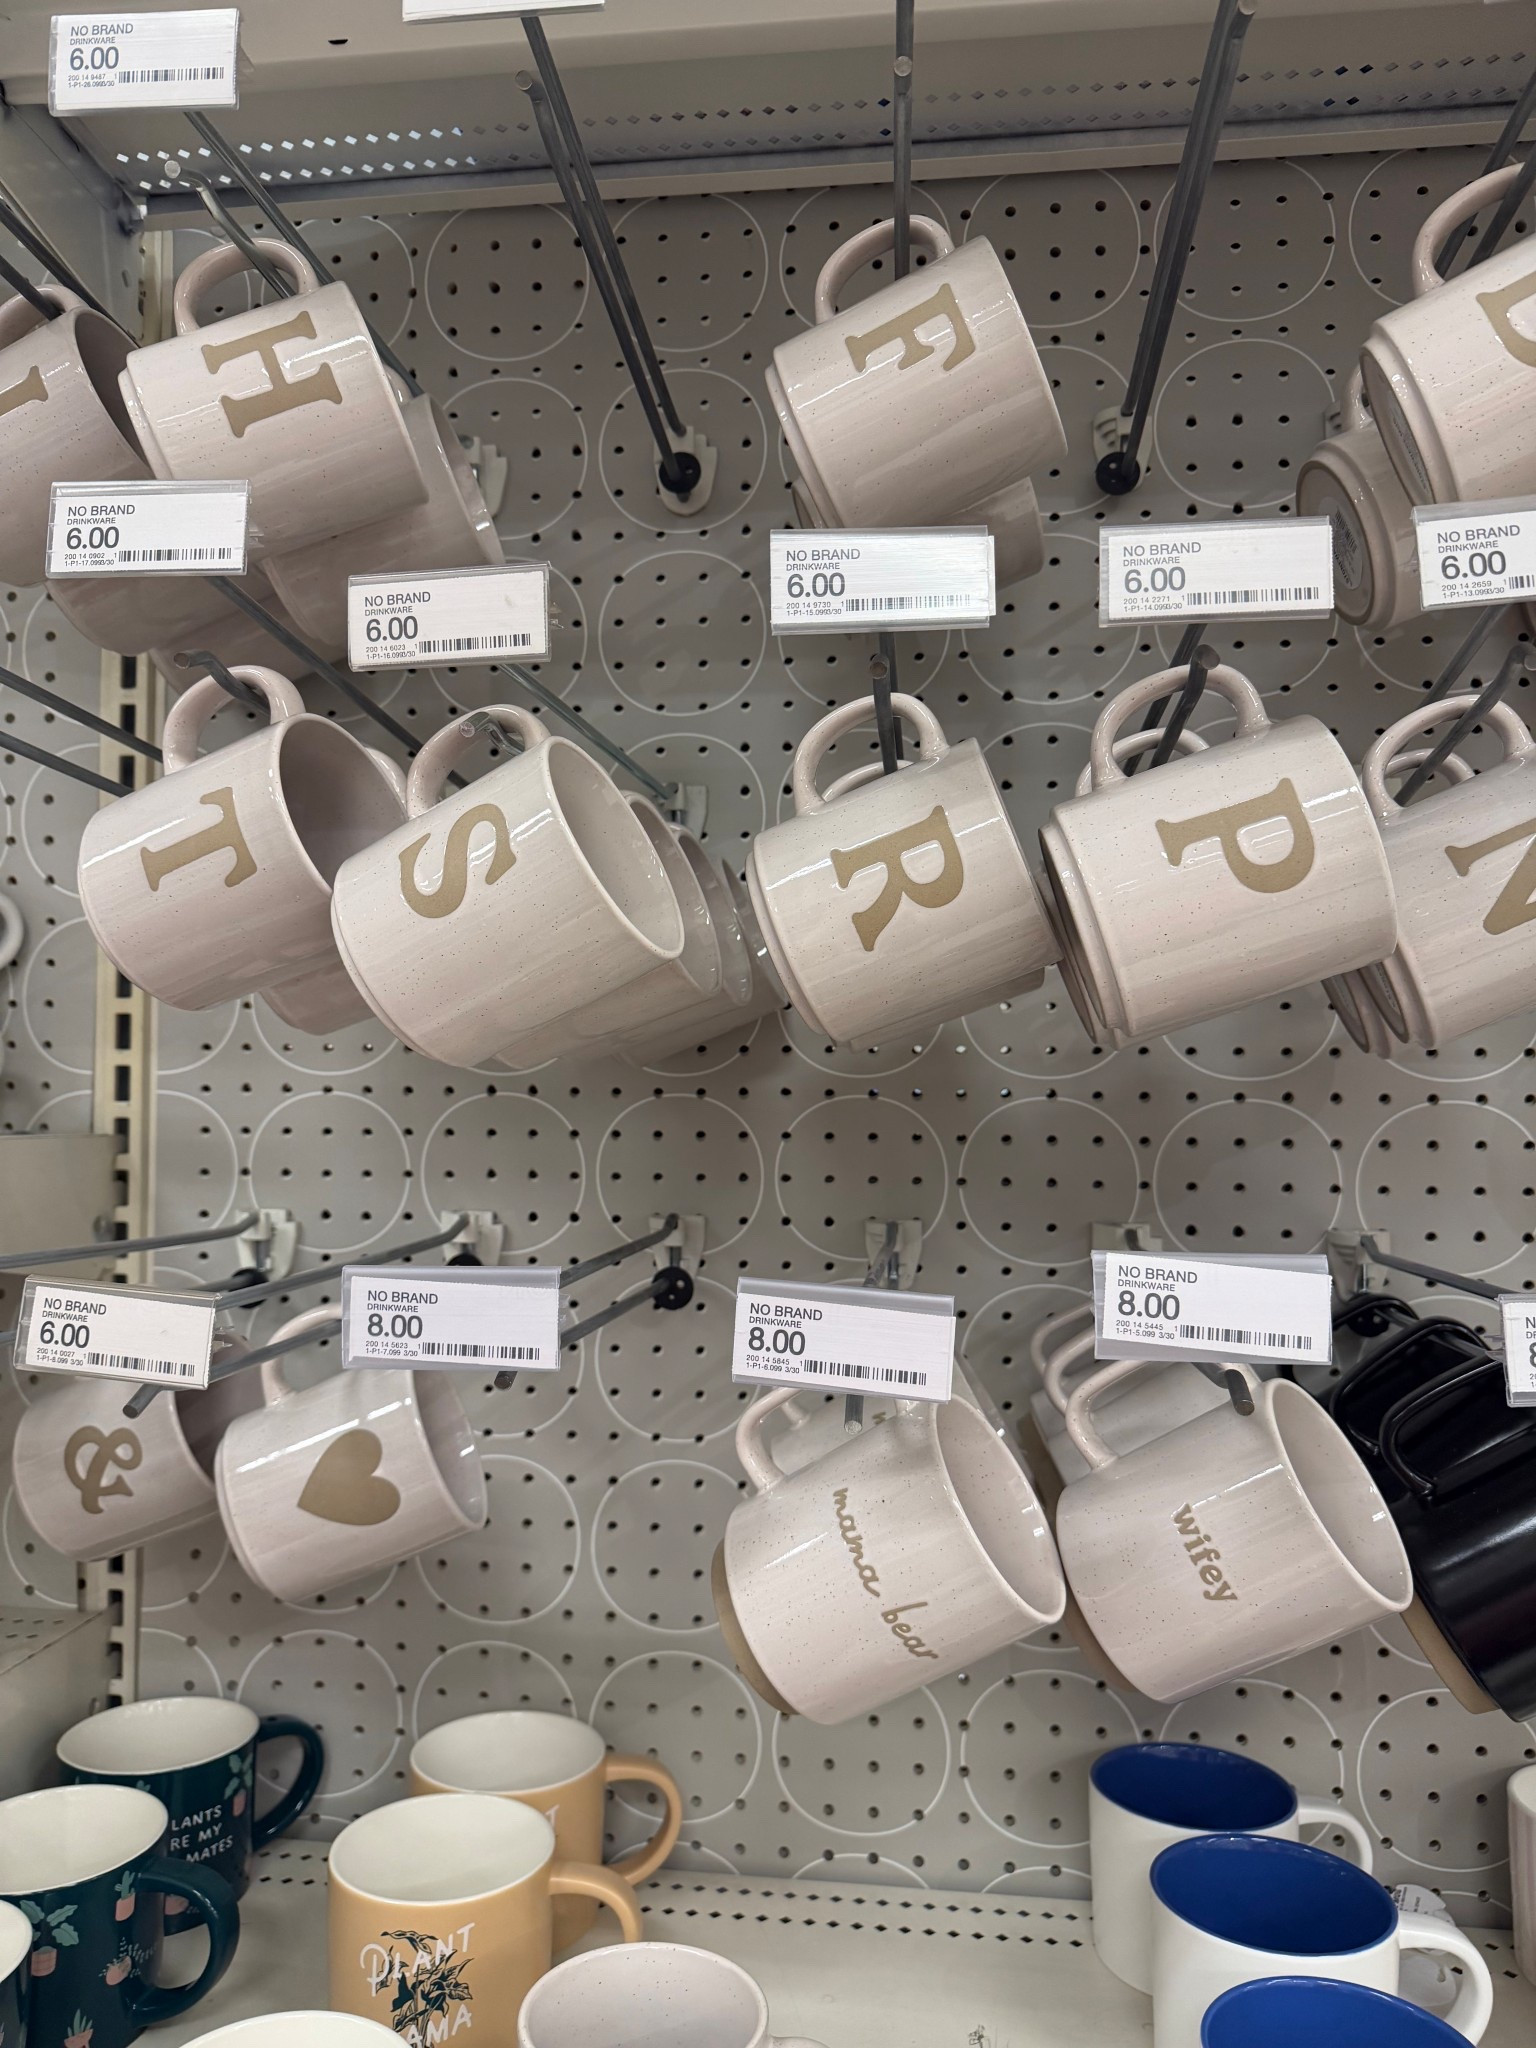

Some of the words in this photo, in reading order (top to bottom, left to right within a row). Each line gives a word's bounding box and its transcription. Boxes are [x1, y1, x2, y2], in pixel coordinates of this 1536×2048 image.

[70, 25, 88, 36] NO
[92, 23, 134, 35] BRAND
[69, 36, 116, 45] DRINKWARE
[69, 46, 119, 71] 6.00
[844, 282, 976, 373] F
[201, 310, 343, 438] H
[68, 506, 87, 517] NO
[90, 504, 135, 516] BRAND
[66, 517, 116, 526] DRINKWARE
[66, 526, 120, 550] 6.00
[1437, 531, 1460, 544] NO
[1465, 524, 1521, 541] BRAND
[786, 550, 807, 562] NO
[812, 548, 861, 561] BRAND
[1123, 545, 1145, 557] NO
[1150, 541, 1202, 556] BRAND
[1438, 540, 1499, 554] DRINKWARE
[786, 562, 840, 571] DRINKWARE
[1123, 556, 1181, 567] DRINKWARE
[1441, 550, 1506, 580] 6.00
[787, 572, 845, 599] 6.00
[1124, 566, 1186, 594] 6.00
[1441, 584, 1457, 592] 200
[1459, 582, 1469, 590] 14
[1471, 580, 1492, 589] 2659
[364, 595, 383, 607] NO
[387, 591, 431, 606] BRAND
[786, 602, 800, 610] 200
[813, 601, 831, 609] 9730
[1152, 595, 1170, 603] 2271
[364, 606, 413, 616] DRINKWARE
[366, 615, 418, 642] 6.00
[140, 787, 257, 892] T
[1155, 777, 1315, 894] P
[399, 803, 517, 918] S
[830, 805, 964, 952] R
[1118, 1265, 1141, 1278] NO
[1145, 1268, 1198, 1284] BRAND
[1118, 1279, 1176, 1292] DRINKWARE
[44, 1298, 62, 1311] NO
[65, 1300, 106, 1315] BRAND
[367, 1290, 388, 1302] NO
[392, 1292, 438, 1305] BRAND
[1117, 1290, 1180, 1321] 8.00
[42, 1310, 88, 1322] DRINKWARE
[367, 1303, 419, 1313] DRINKWARE
[750, 1302, 770, 1316] NO
[774, 1305, 823, 1321] BRAND
[367, 1313, 423, 1339] 8.00
[749, 1316, 802, 1329] DRINKWARE
[1115, 1320, 1130, 1328] 200
[1144, 1322, 1164, 1331] 5445
[40, 1320, 90, 1349] 6.00
[365, 1340, 379, 1348] 200
[748, 1326, 806, 1356] 8.00
[1158, 1332, 1175, 1340] 3/30
[746, 1354, 760, 1362] 200
[1174, 1503, 1238, 1601] wifey
[832, 1487, 881, 1598] mama
[881, 1601, 939, 1659] bear
[171, 1804, 222, 1831] LANTS
[170, 1834, 190, 1851] RE
[198, 1822, 222, 1842] MY
[360, 1922, 475, 1997] PLANT
[406, 2004, 473, 2048] AMA
